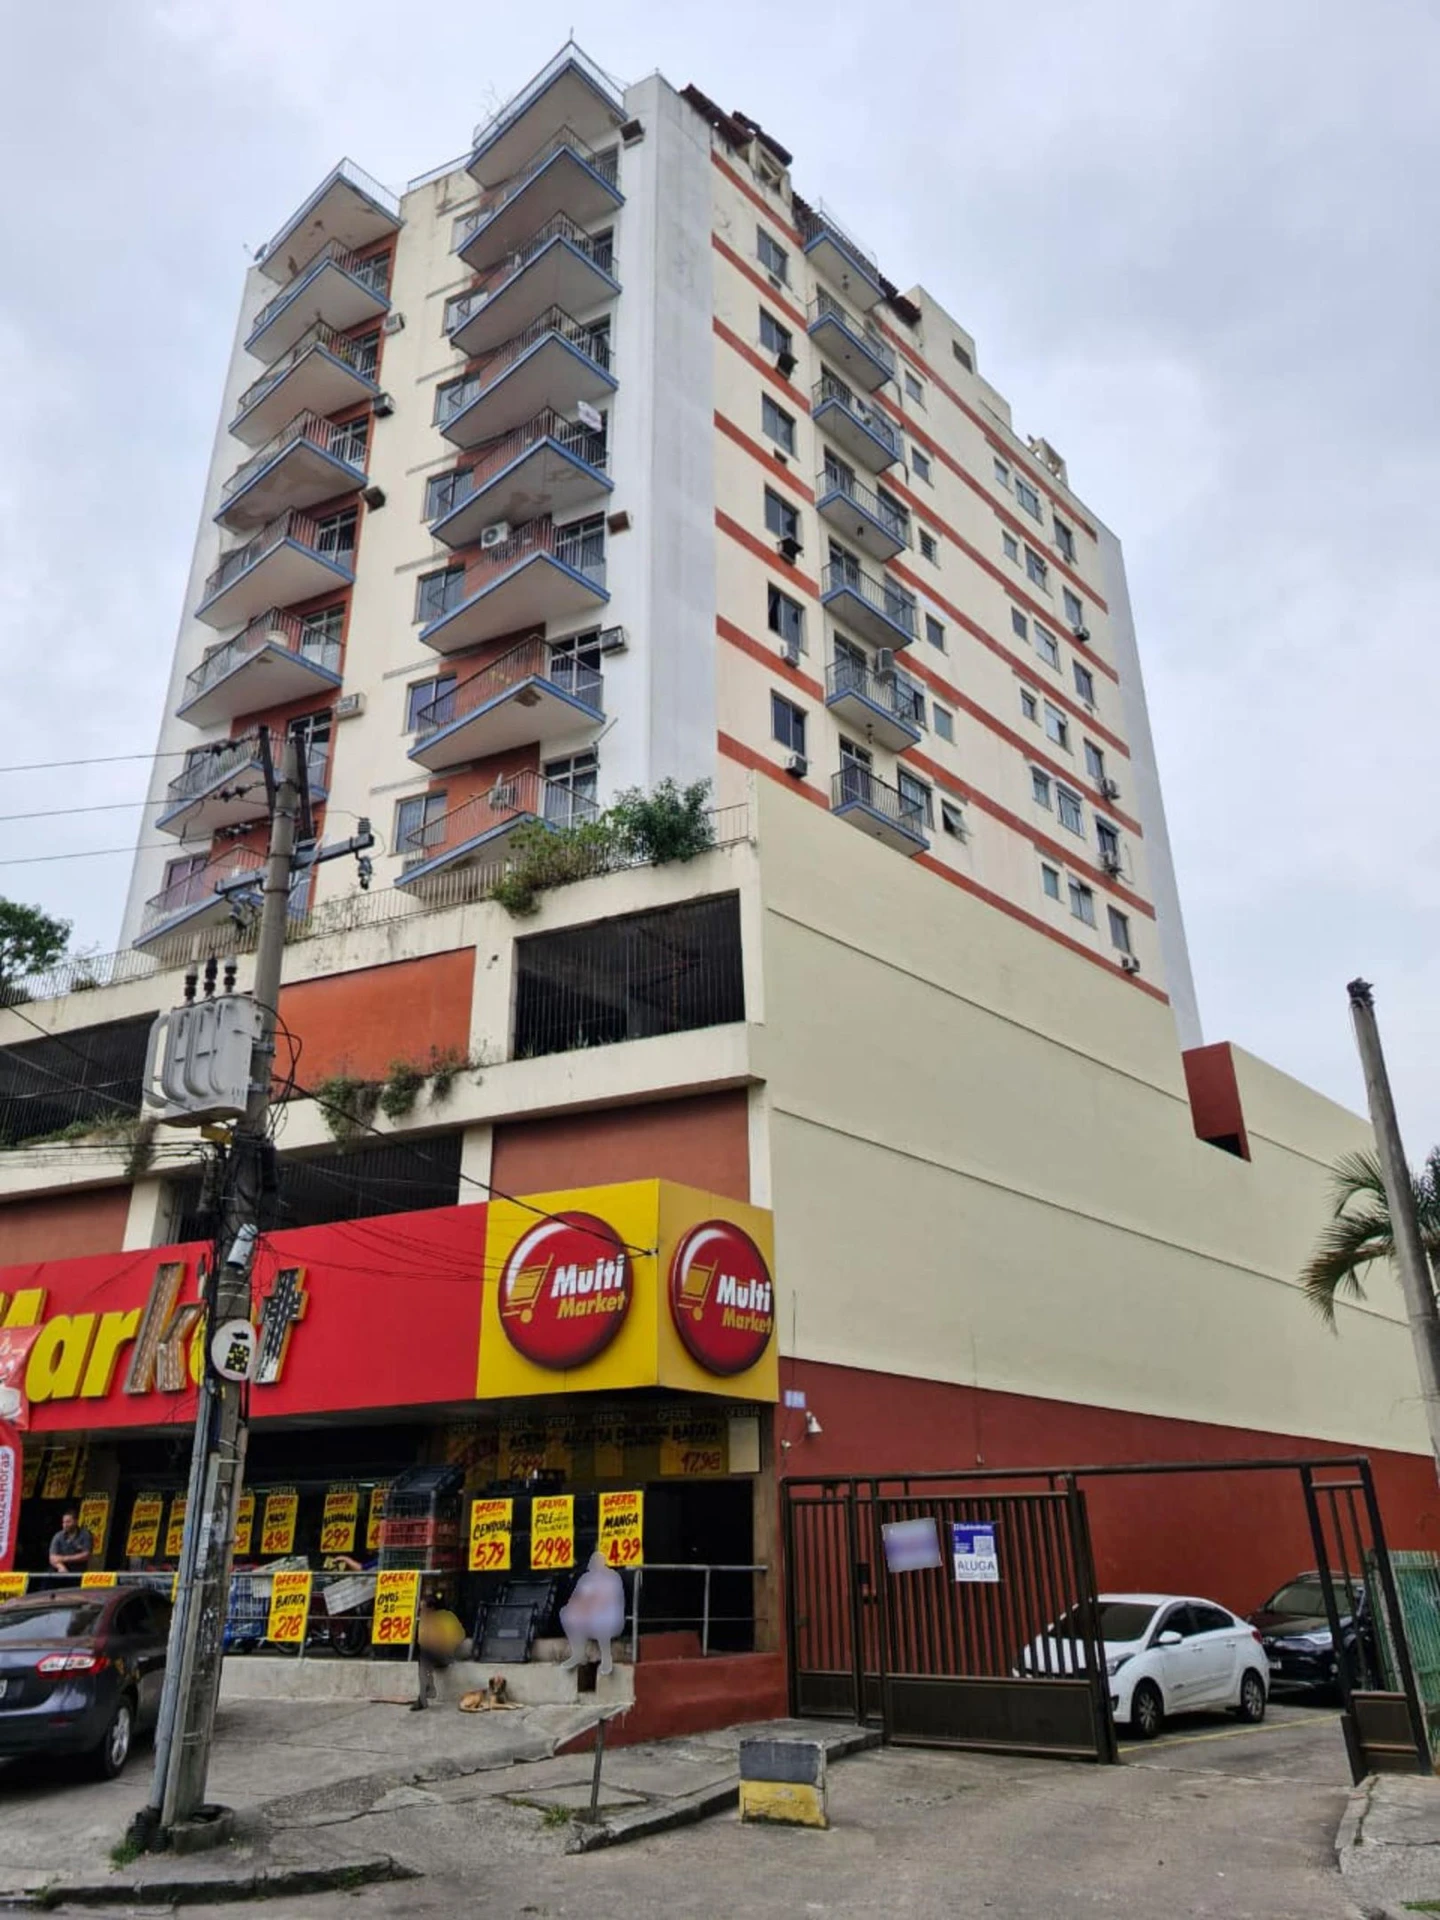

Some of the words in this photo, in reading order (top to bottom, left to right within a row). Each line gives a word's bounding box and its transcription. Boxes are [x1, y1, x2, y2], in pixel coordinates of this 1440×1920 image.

[551, 1254, 625, 1297] Multi
[716, 1275, 771, 1312] Multi
[556, 1295, 625, 1319] Market
[722, 1308, 773, 1332] Market
[0, 1261, 307, 1404] arkt
[603, 1512, 638, 1529] MANGA
[957, 1560, 996, 1572] ALUGA
